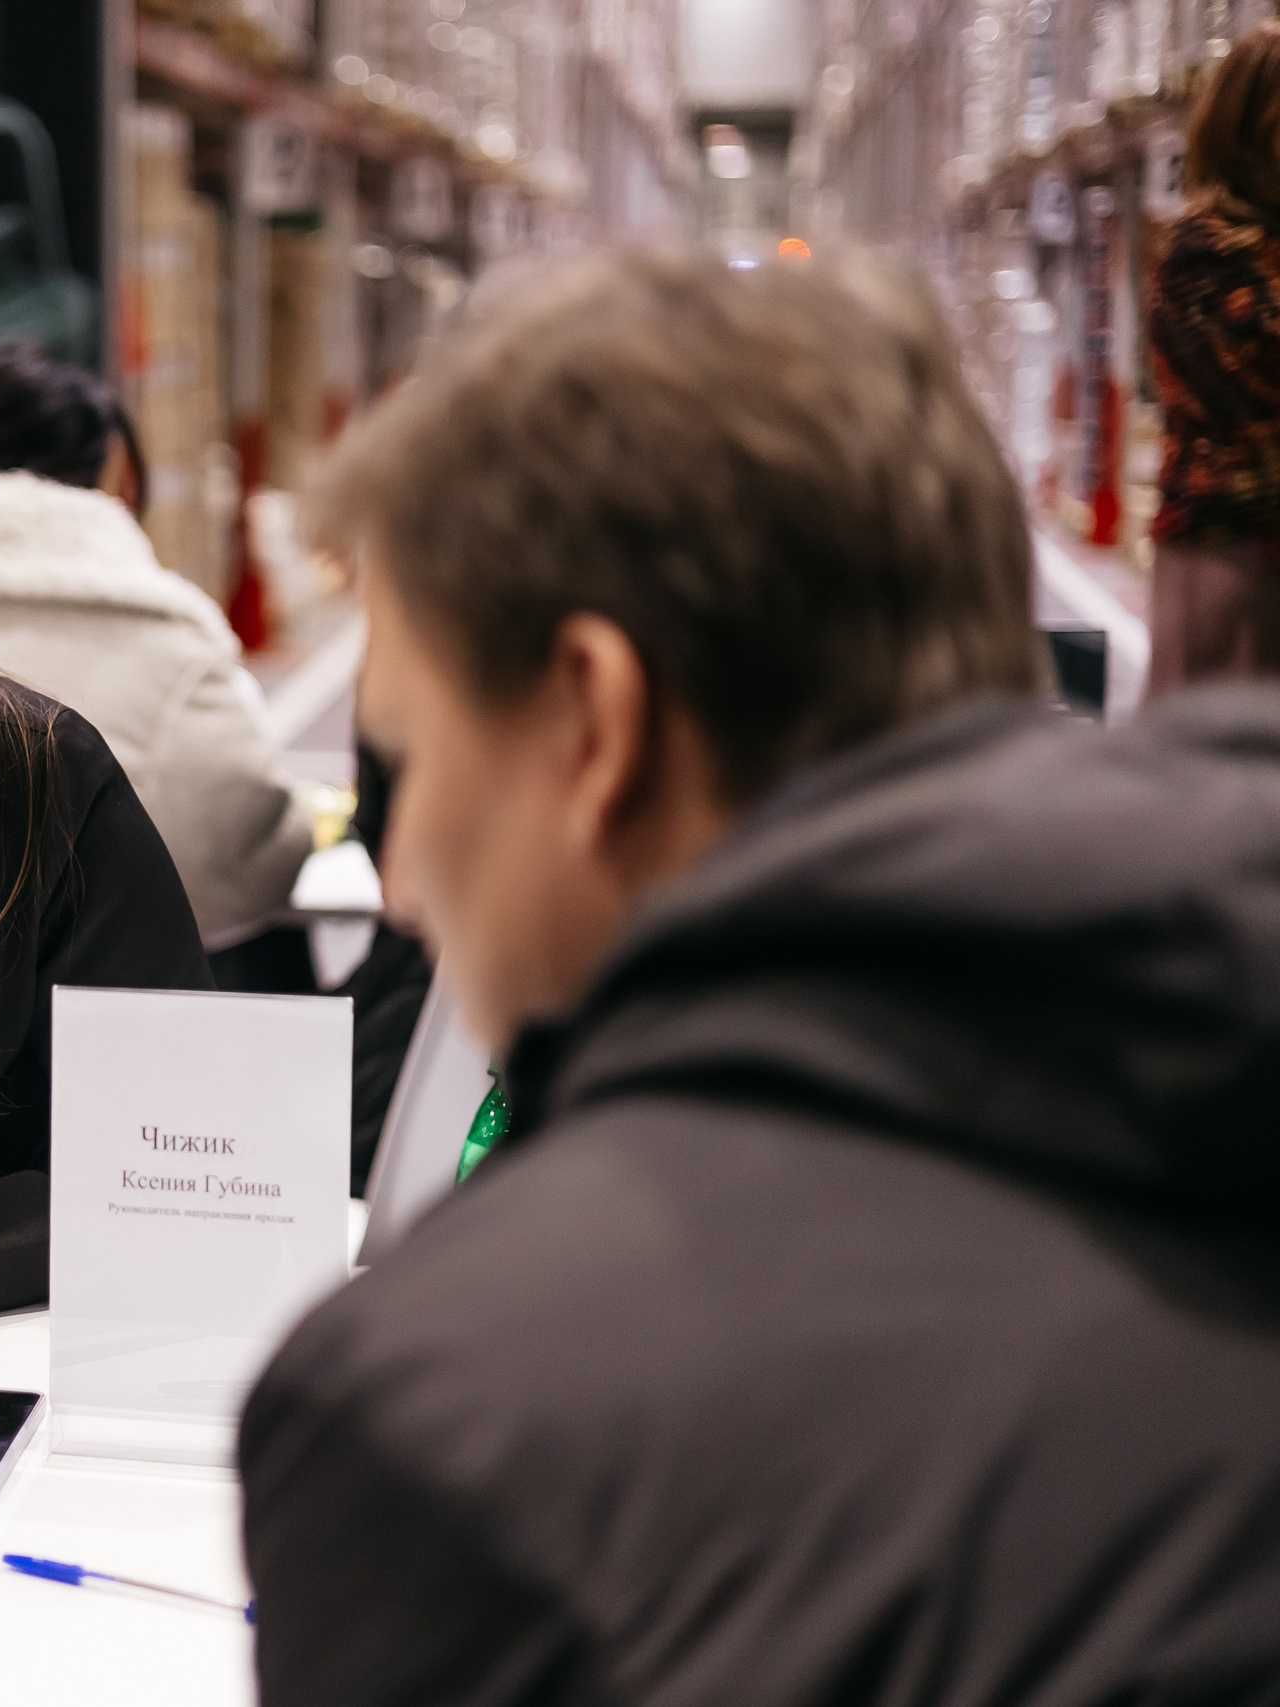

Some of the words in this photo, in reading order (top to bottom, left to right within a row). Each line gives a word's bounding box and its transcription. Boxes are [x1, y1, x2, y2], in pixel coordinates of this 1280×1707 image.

[140, 1125, 236, 1155] Чижик
[121, 1169, 197, 1193] Ксения
[204, 1174, 282, 1199] Губина
[108, 1202, 181, 1217] Руководитель
[184, 1207, 252, 1222] направления
[254, 1212, 295, 1225] продаж
